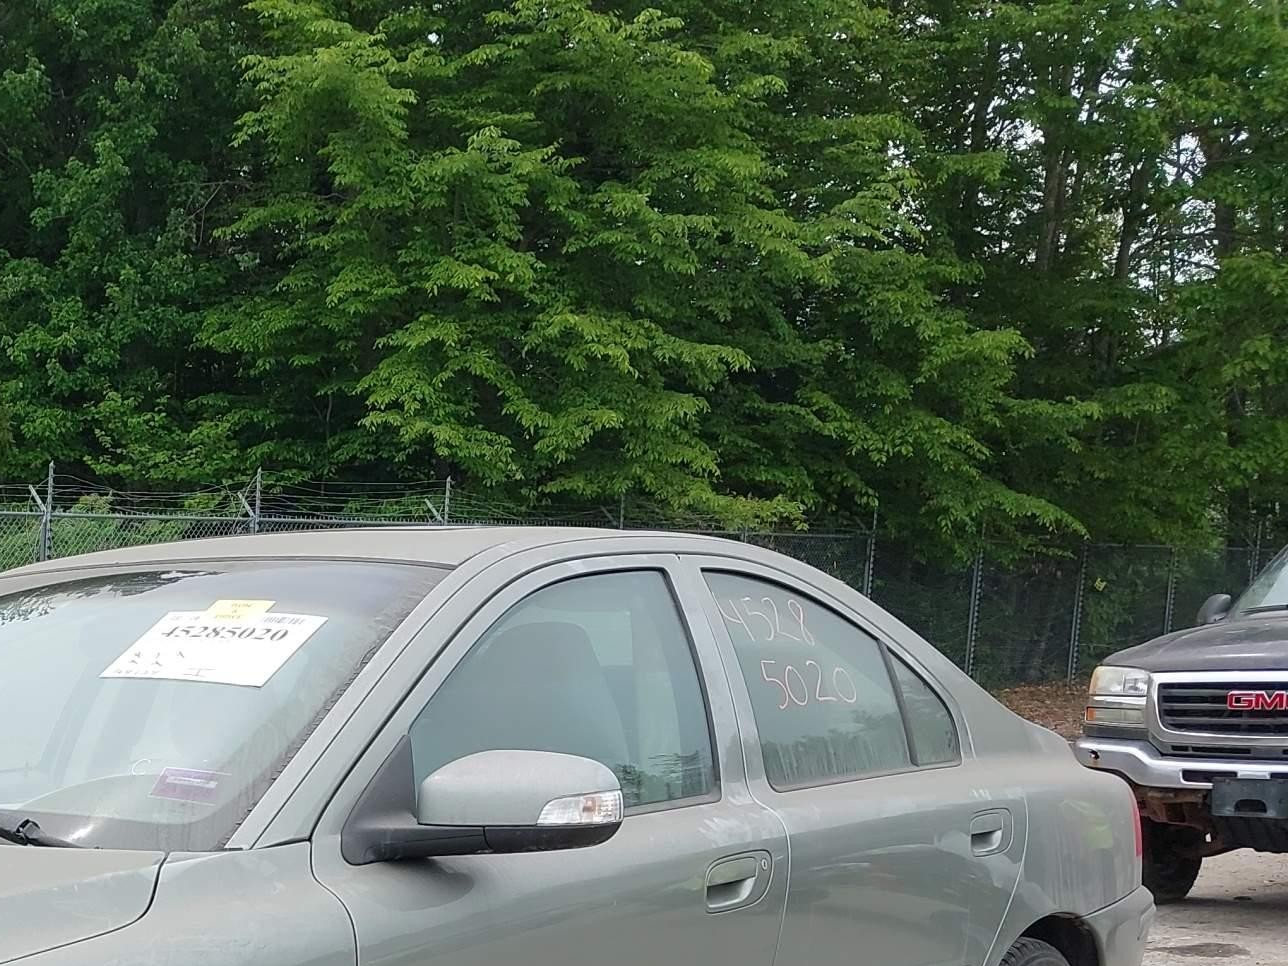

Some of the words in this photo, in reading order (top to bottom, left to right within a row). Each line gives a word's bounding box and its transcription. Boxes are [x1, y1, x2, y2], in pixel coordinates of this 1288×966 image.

[161, 625, 289, 642] 45285020
[713, 594, 814, 645] 4528
[761, 660, 857, 709] 5020
[1227, 690, 1288, 710] GM
